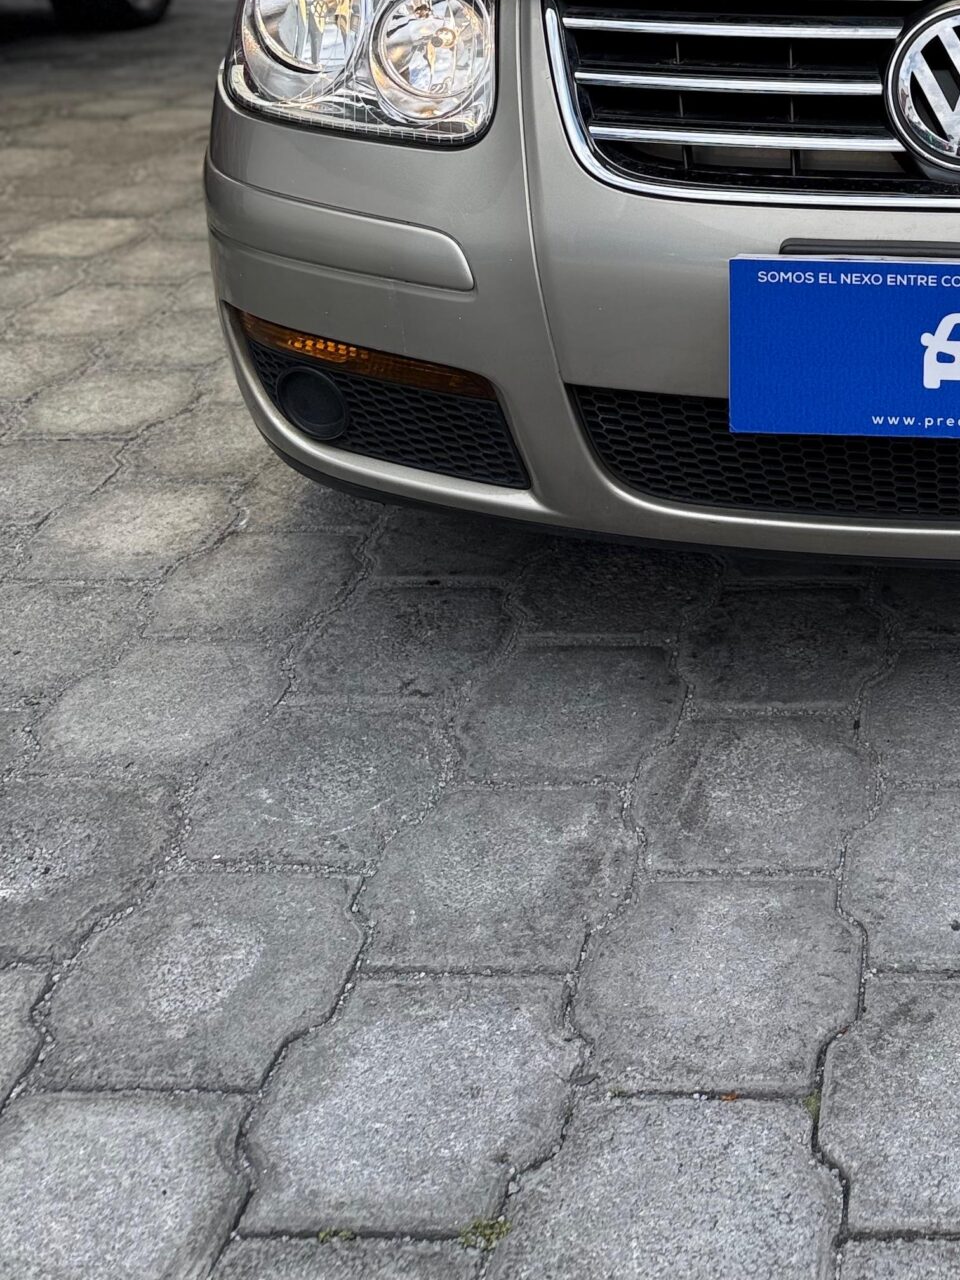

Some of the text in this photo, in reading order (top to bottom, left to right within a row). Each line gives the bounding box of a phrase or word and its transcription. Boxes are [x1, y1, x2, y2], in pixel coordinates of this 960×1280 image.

[757, 271, 815, 284] SOMOS
[818, 272, 838, 285] EL
[840, 273, 883, 286] NEXO
[887, 274, 938, 287] ENTRE
